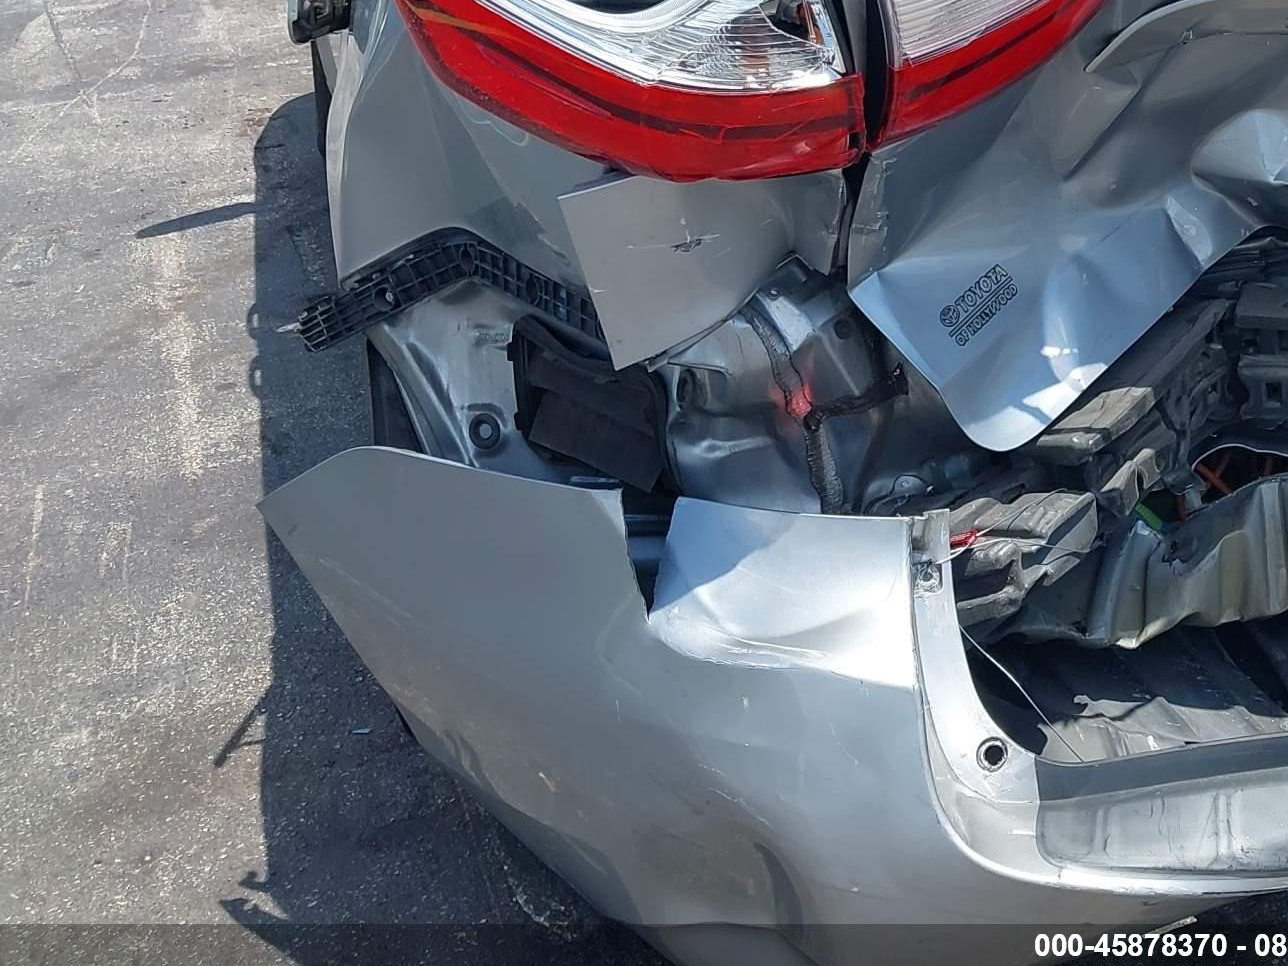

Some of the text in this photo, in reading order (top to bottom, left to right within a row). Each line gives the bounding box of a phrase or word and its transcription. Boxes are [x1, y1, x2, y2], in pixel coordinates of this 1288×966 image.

[954, 264, 1008, 313] TOYOTA
[955, 283, 1018, 346] OF HOLLYWOOD
